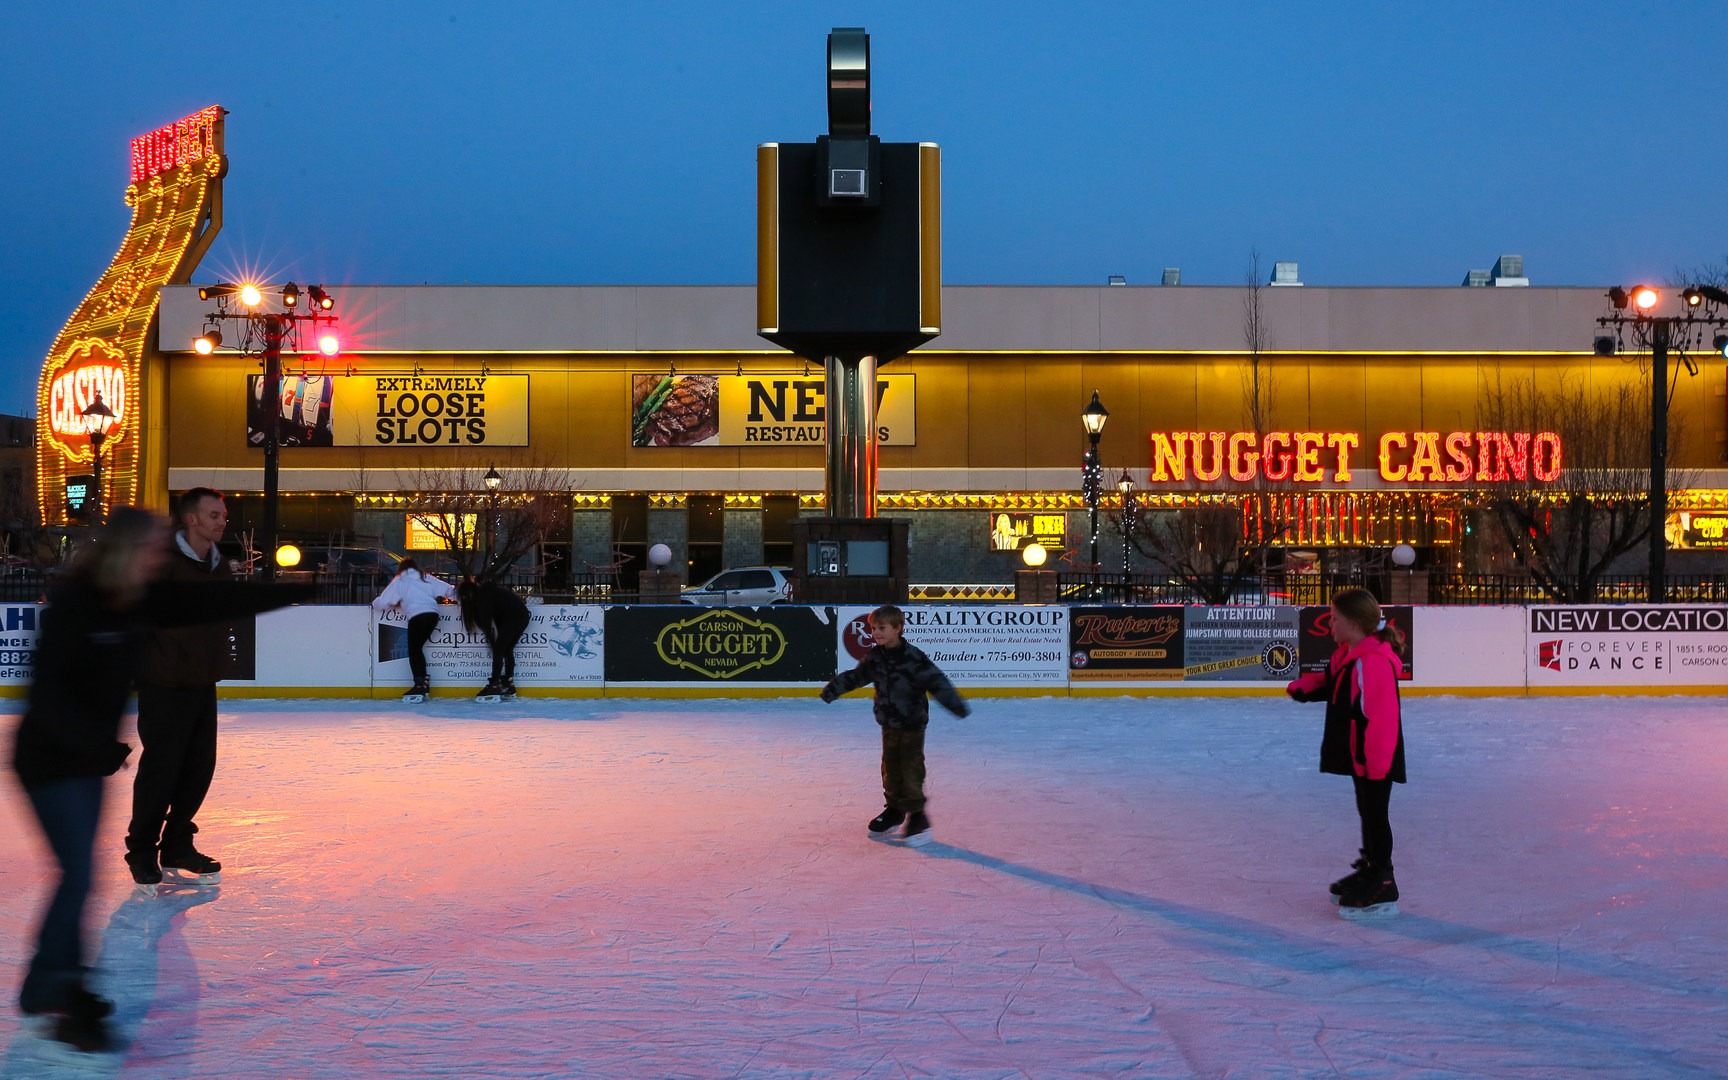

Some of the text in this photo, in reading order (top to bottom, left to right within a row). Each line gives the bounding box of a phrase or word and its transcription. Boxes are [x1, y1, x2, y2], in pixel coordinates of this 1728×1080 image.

[130, 104, 219, 183] NUGGET
[376, 378, 487, 391] EXTREMELY
[376, 393, 485, 418] LOOSE
[747, 381, 889, 422] NE
[375, 418, 486, 444] SLOTS
[745, 426, 889, 442] RESTAUS
[1150, 431, 1563, 483] NUGGET CASINO
[549, 611, 589, 622] season!
[1206, 608, 1276, 620] ATTENTION!
[1537, 610, 1728, 631] NEW LOCATIO
[699, 622, 744, 632] CARSON
[1076, 614, 1180, 647] Rupert's
[1185, 629, 1298, 638] JUMPSTART YOUR COLLEGE CAREER
[428, 628, 548, 648] Capita ass
[670, 633, 773, 655] NUGGET
[916, 636, 945, 645] Complete
[946, 636, 966, 644] Source
[968, 636, 980, 644] For
[981, 636, 992, 644] All
[992, 636, 1006, 644] Your
[1007, 636, 1022, 644] Real
[1022, 636, 1041, 644] Estate
[1043, 636, 1062, 644] Needs
[1568, 641, 1663, 653] FOREVER
[1676, 645, 1695, 653] 1851
[431, 651, 484, 659] COMMERCIAL
[932, 651, 978, 662] Bawden
[987, 651, 1062, 662] 775-690-3804
[704, 658, 738, 667] NEVADA
[1185, 656, 1259, 675] YOUR NEXT GREAT CHOICE
[1568, 657, 1663, 670] DANCE
[1681, 658, 1719, 666] CARSON
